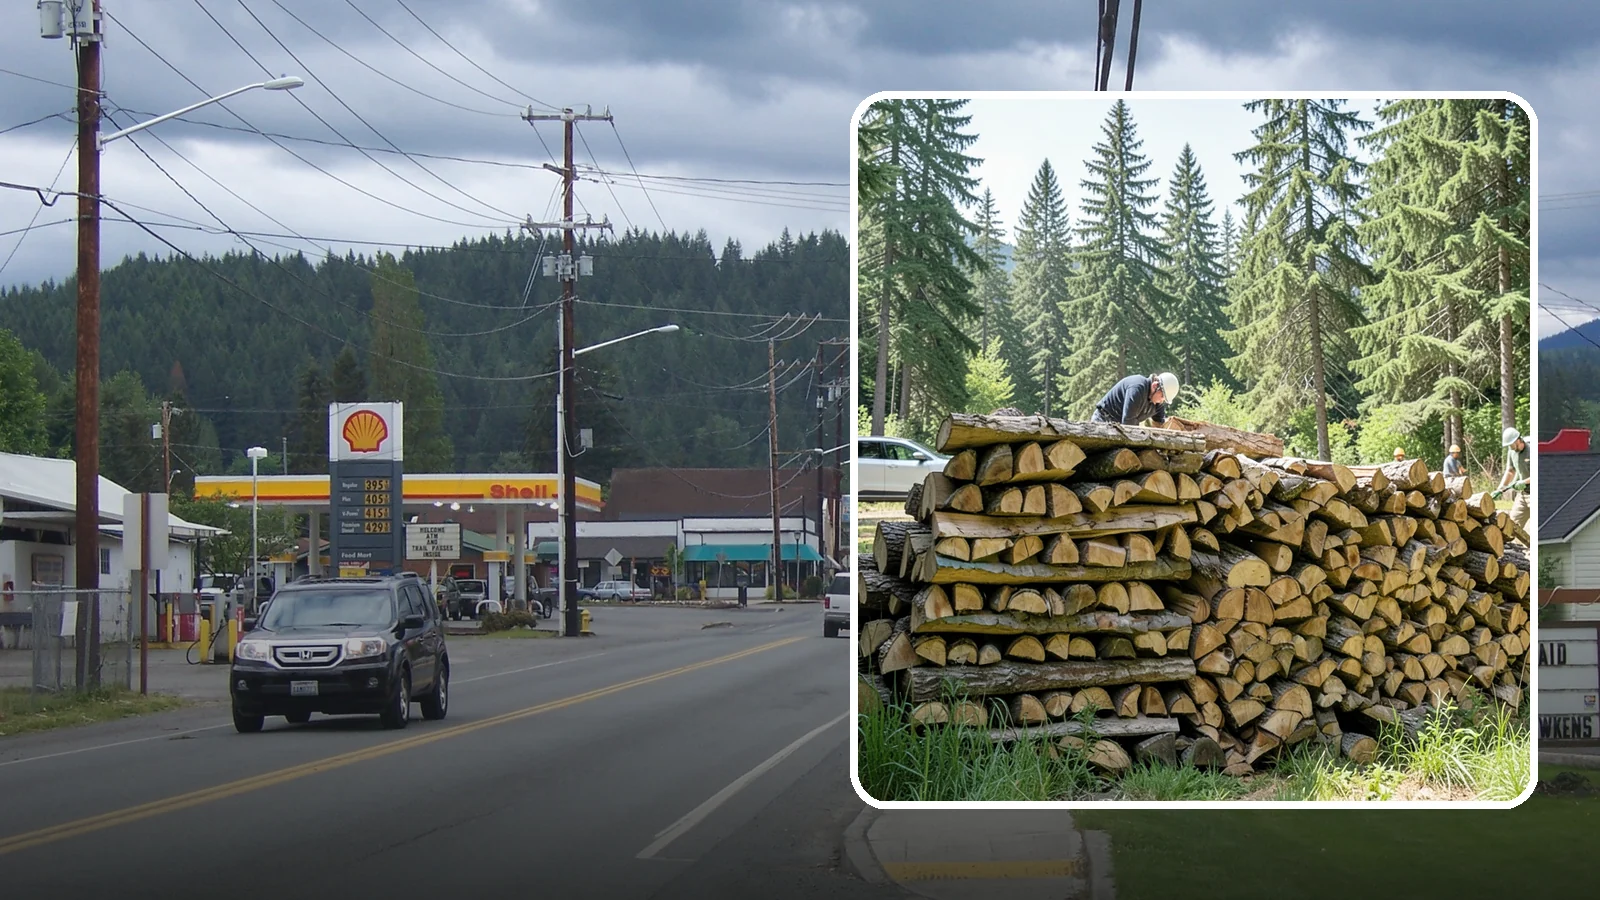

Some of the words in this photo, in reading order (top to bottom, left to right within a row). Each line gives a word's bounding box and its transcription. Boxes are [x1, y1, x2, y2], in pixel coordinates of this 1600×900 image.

[366, 480, 383, 490] 395
[490, 484, 547, 499] Shell
[366, 494, 383, 504] 405
[366, 508, 383, 518] 415
[366, 522, 383, 532] 429
